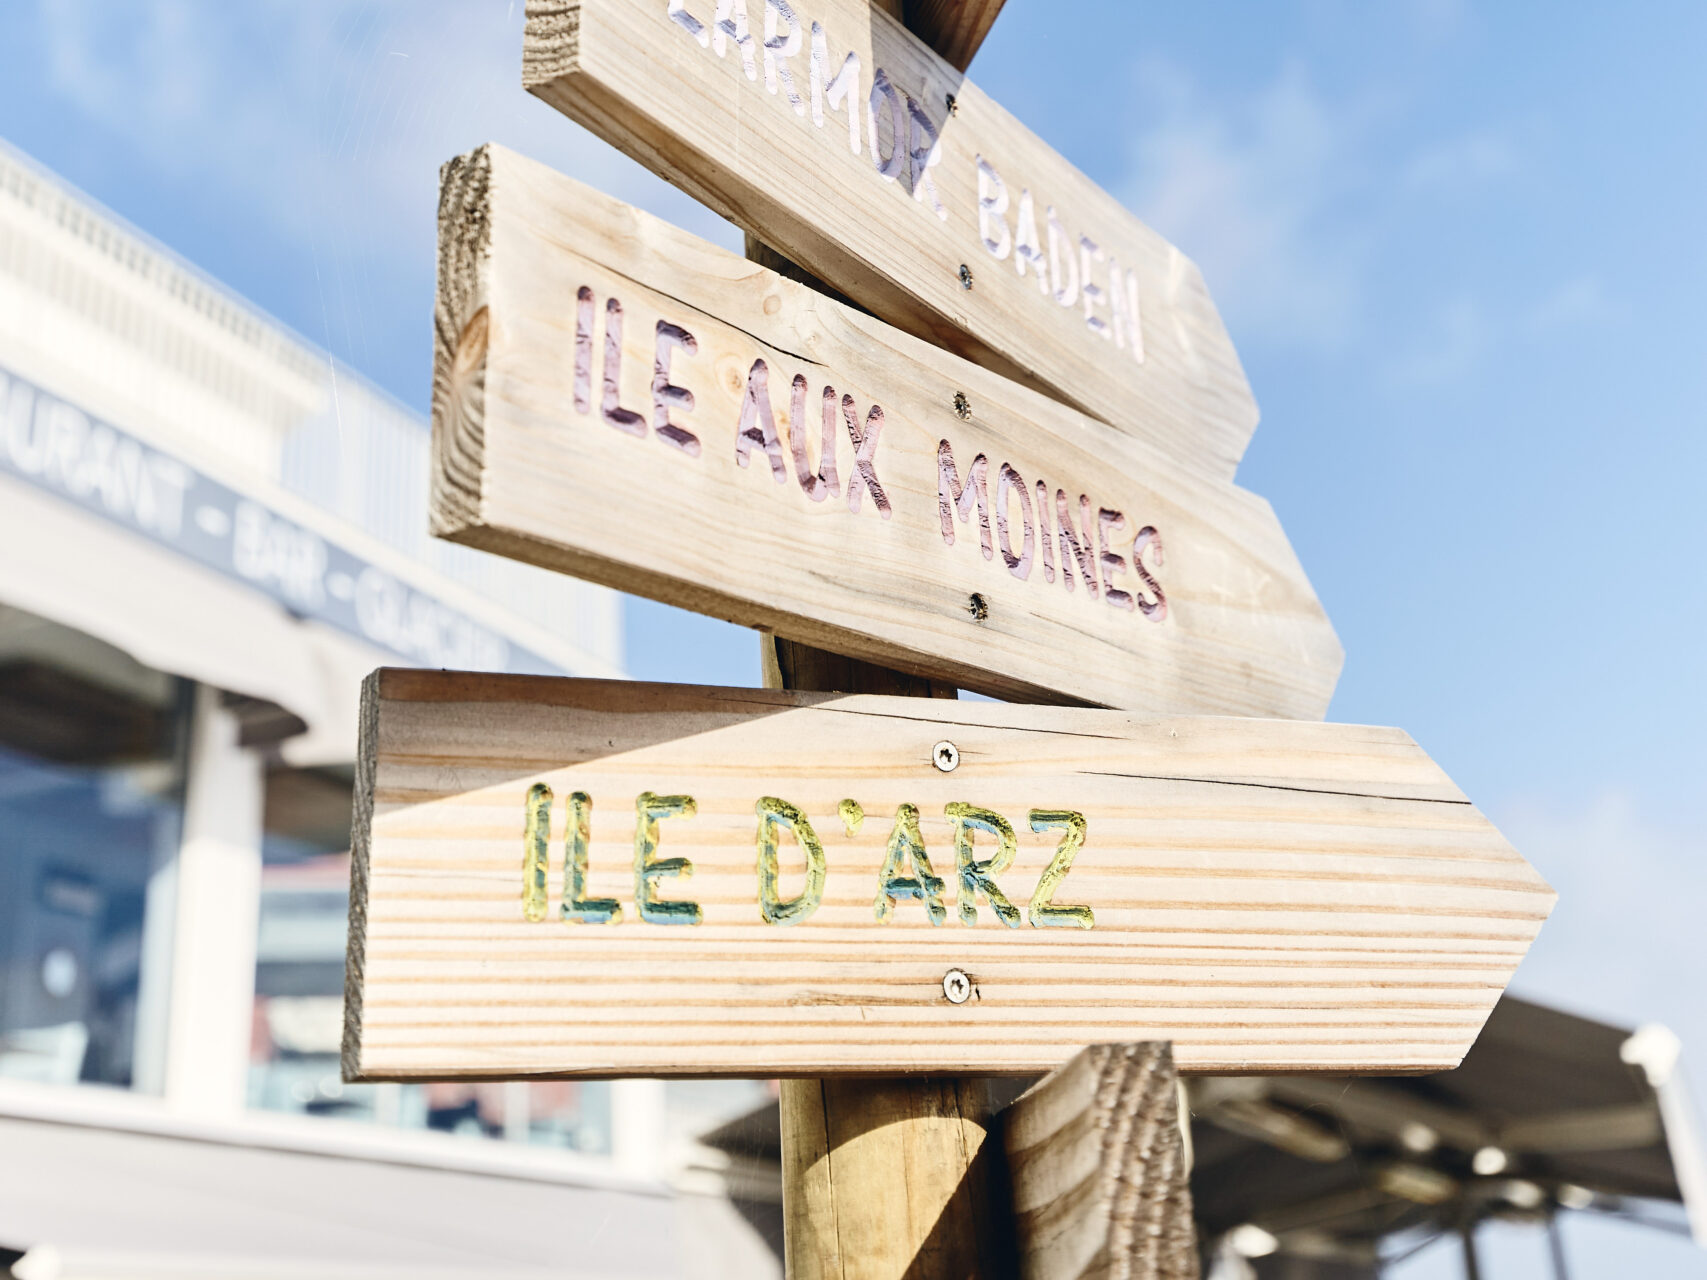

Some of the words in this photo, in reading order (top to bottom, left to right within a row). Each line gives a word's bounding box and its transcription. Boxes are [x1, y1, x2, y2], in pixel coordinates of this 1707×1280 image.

[975, 153, 1146, 364] BADEN
[0, 374, 196, 539] URANT
[573, 285, 701, 458] ILE
[735, 357, 893, 520] AUX
[937, 438, 1169, 621] MOINES
[522, 782, 703, 925] ILE
[755, 795, 1095, 929] D'ARZ
